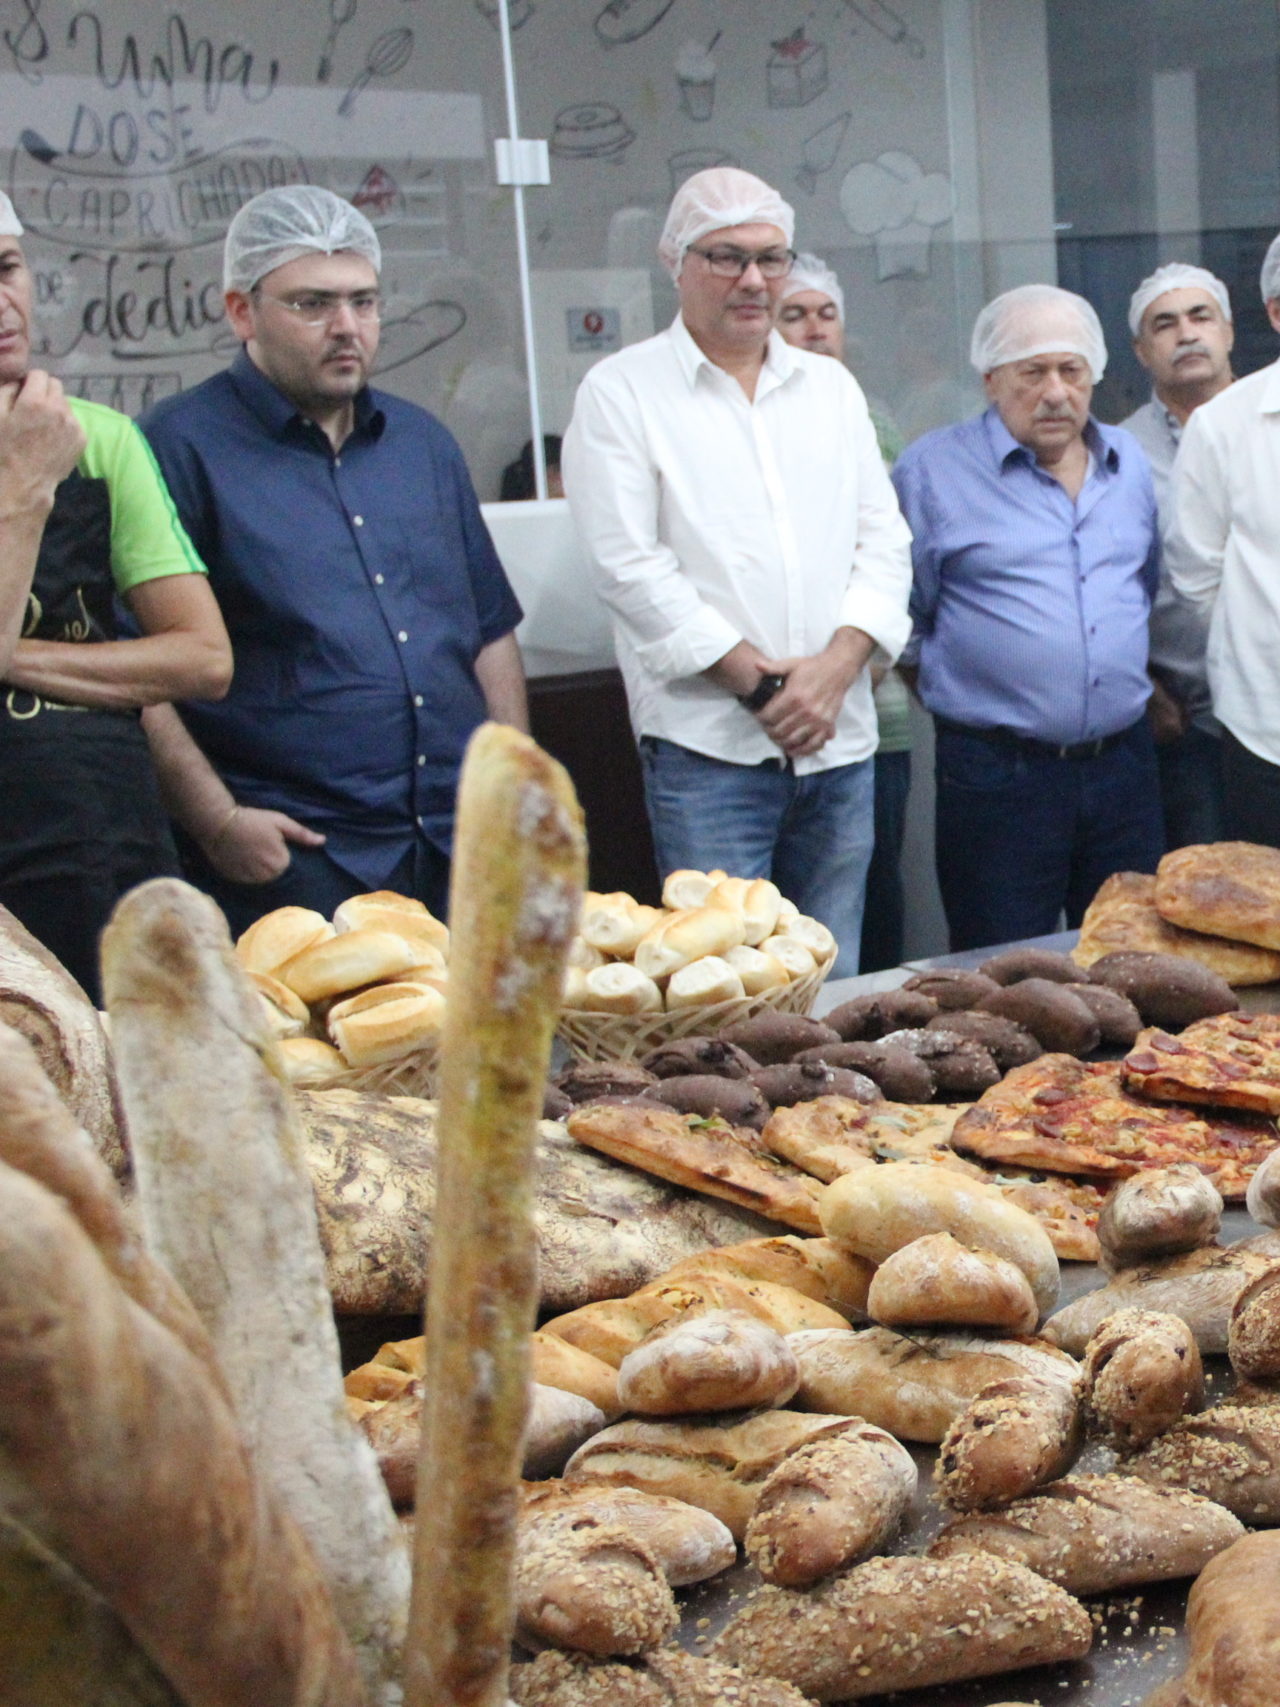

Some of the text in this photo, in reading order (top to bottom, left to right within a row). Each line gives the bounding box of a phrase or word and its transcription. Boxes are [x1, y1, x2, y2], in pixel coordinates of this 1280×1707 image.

[67, 103, 203, 167] DOSE
[45, 155, 287, 239] CAPRICHADA
[54, 252, 229, 354] dedic
